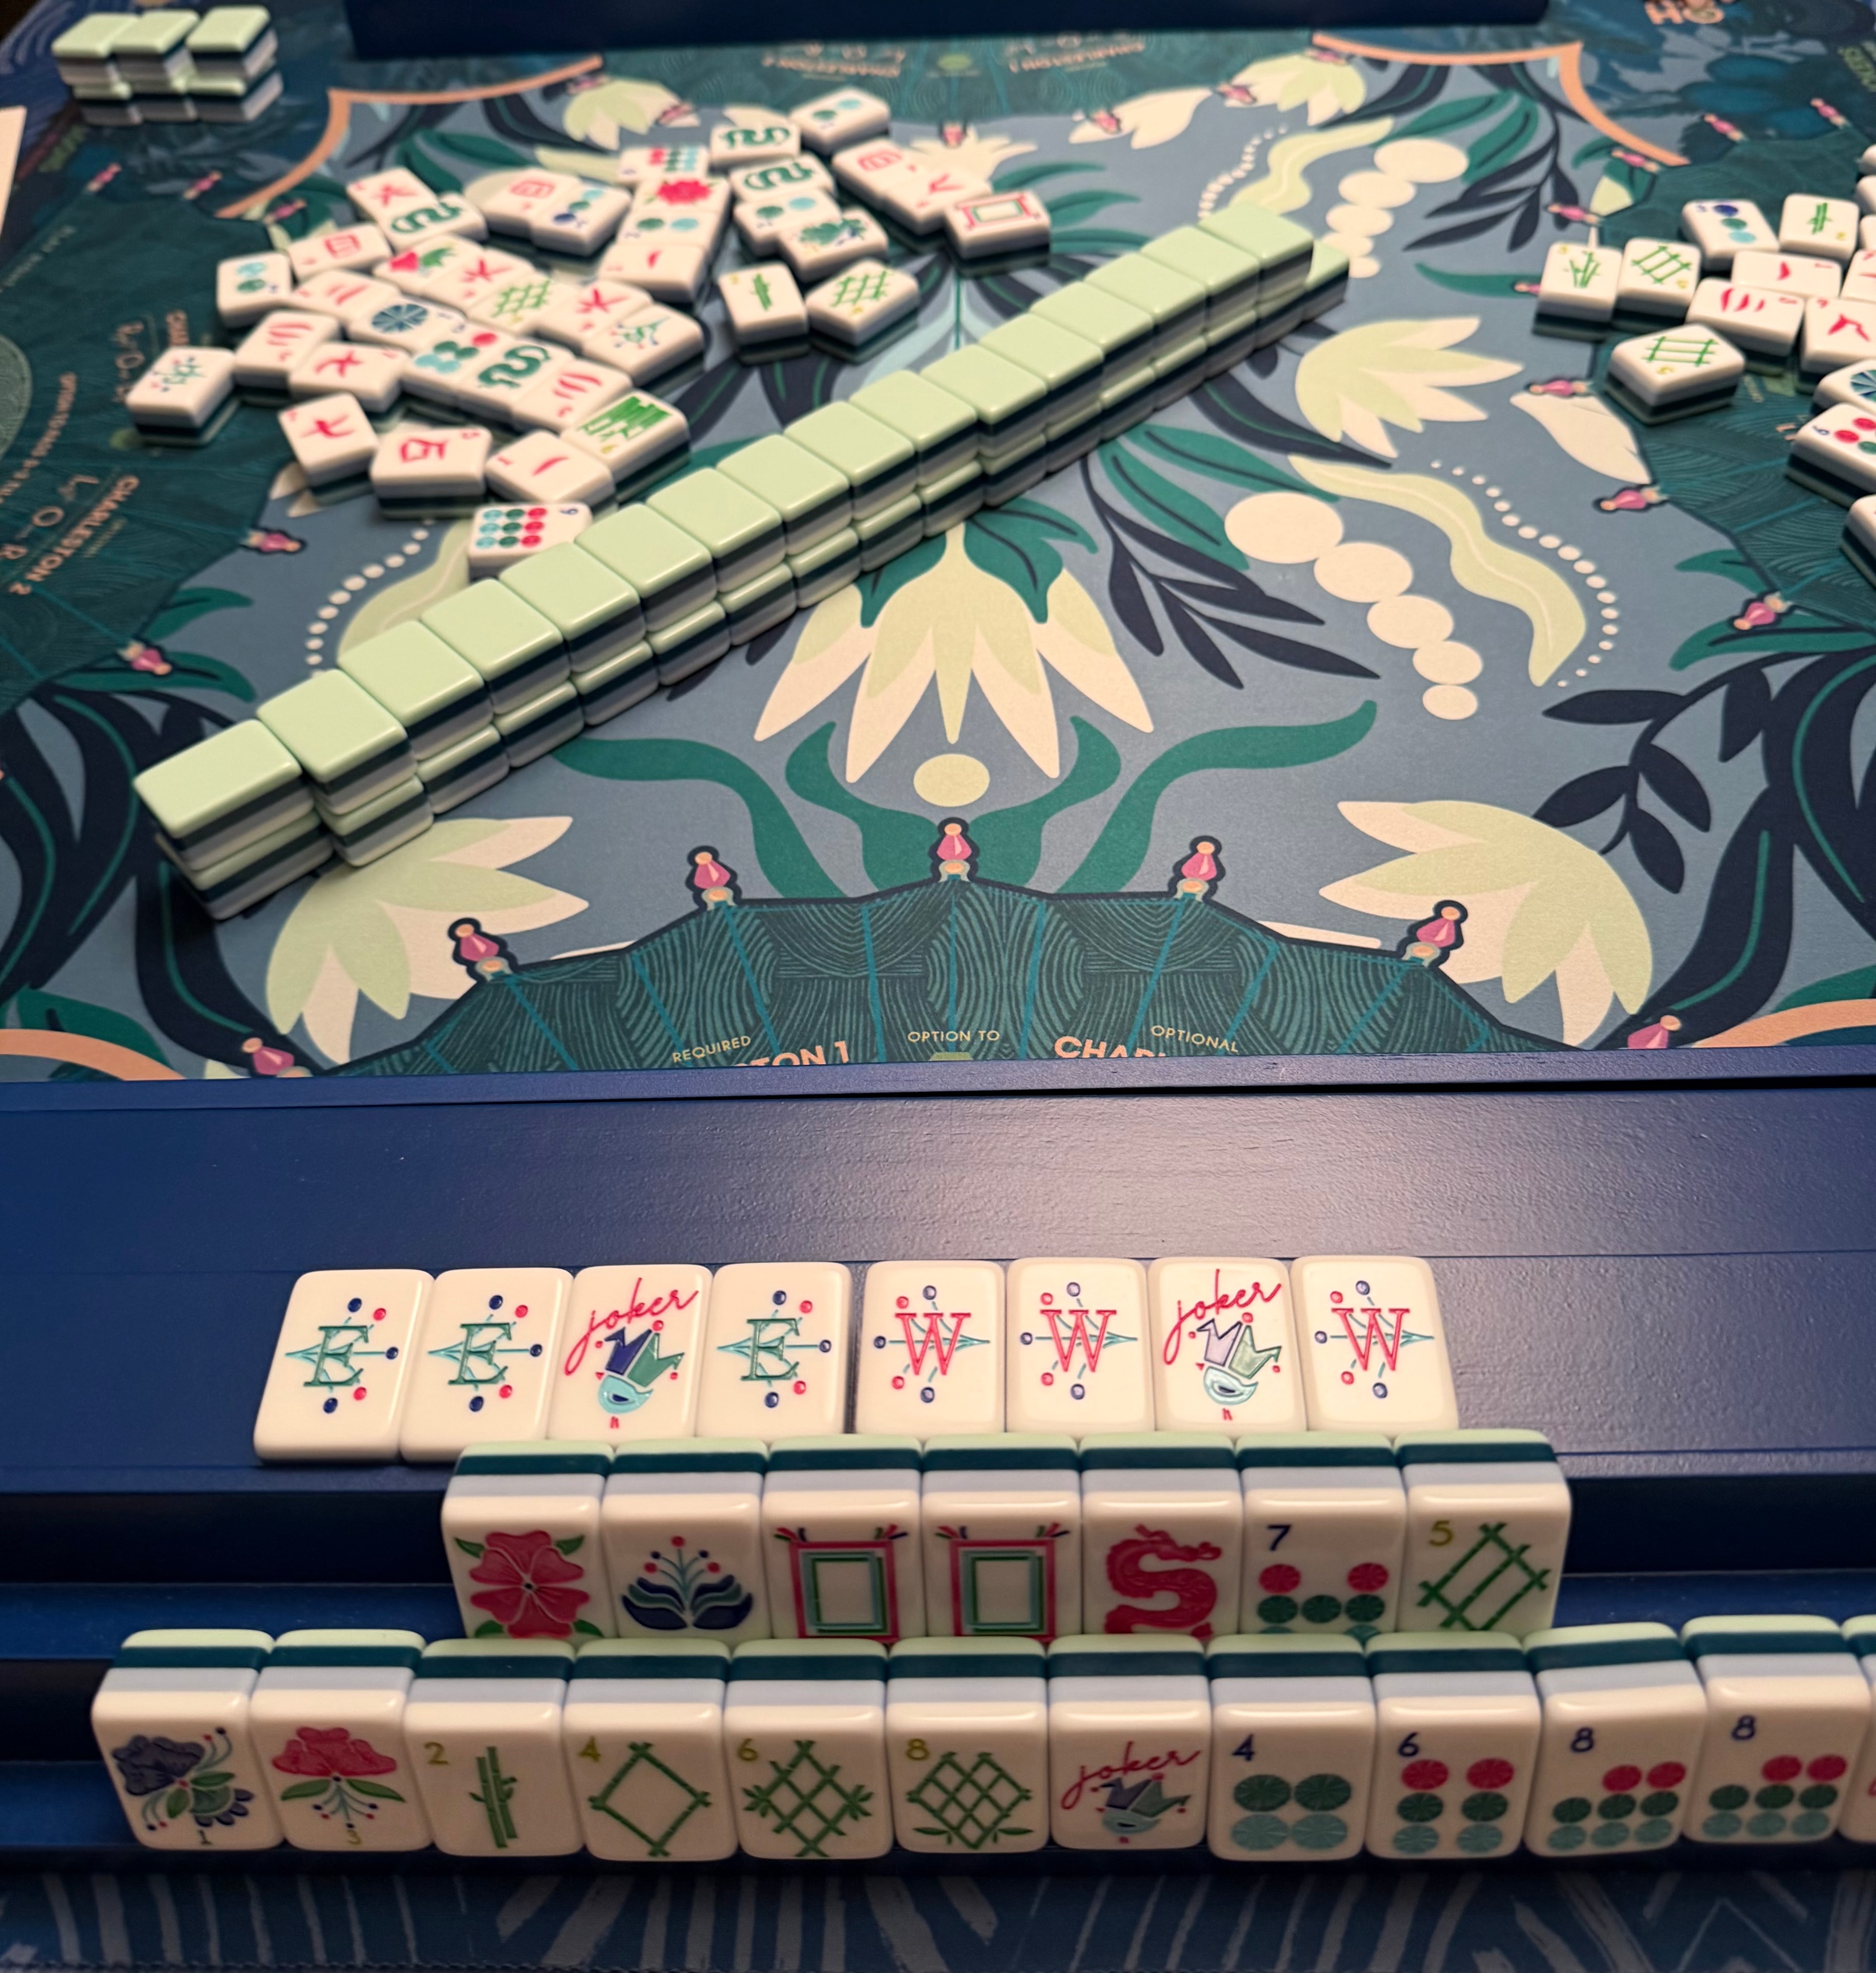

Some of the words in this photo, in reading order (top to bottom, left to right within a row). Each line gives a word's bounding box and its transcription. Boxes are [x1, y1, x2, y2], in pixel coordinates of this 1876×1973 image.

[672, 1035, 752, 1063] REQUIRED
[907, 1030, 971, 1043] OPTION
[978, 1030, 1001, 1041] TO
[1151, 1025, 1239, 1053] OPTIONAL
[834, 1040, 849, 1064] 1
[565, 1277, 699, 1376] joker
[1162, 1269, 1282, 1365] joker
[894, 1312, 971, 1376] W
[1040, 1309, 1117, 1372] W
[1330, 1308, 1411, 1371] W
[1266, 1524, 1292, 1551] 7
[1429, 1519, 1454, 1547] 5
[1569, 1726, 1595, 1753] 8
[1731, 1714, 1757, 1741] 8
[423, 1741, 449, 1765] 2
[577, 1735, 602, 1763] 4
[737, 1738, 759, 1762] 6
[905, 1738, 930, 1761] 8
[1231, 1734, 1255, 1762] 4
[1397, 1731, 1420, 1758] 6
[1060, 1740, 1202, 1810] joker
